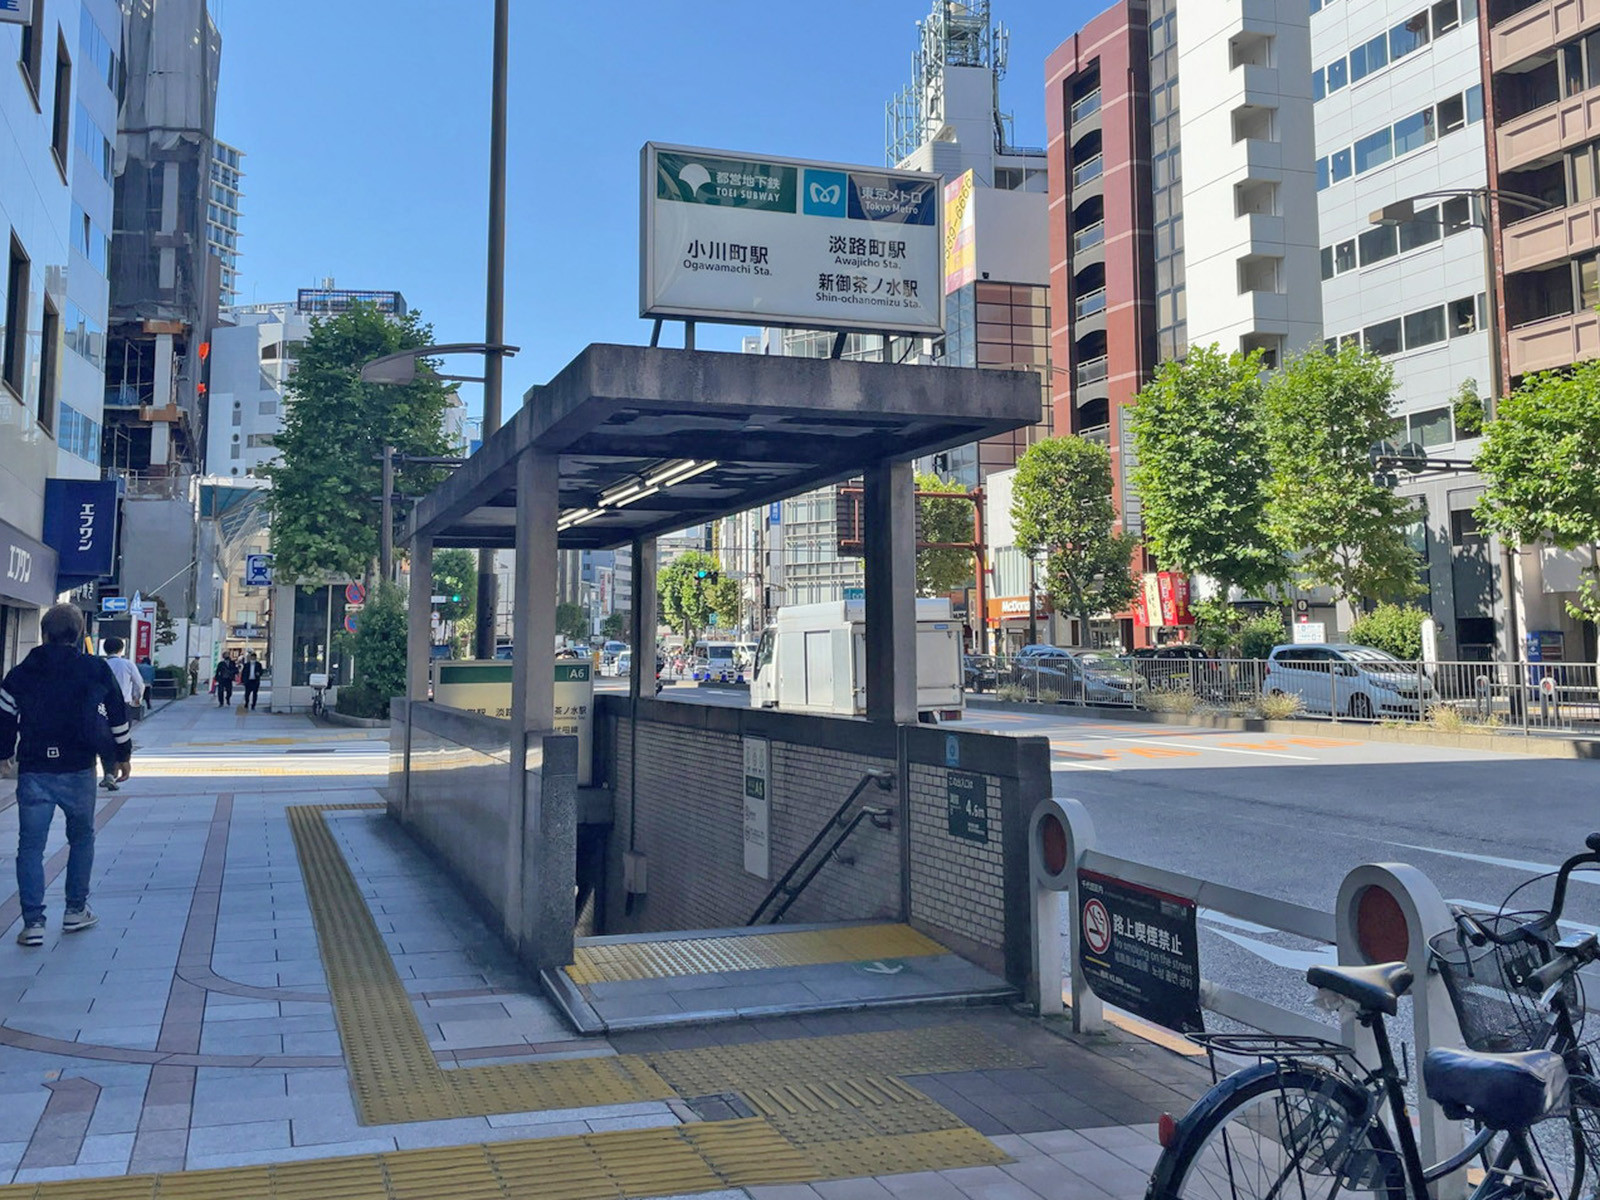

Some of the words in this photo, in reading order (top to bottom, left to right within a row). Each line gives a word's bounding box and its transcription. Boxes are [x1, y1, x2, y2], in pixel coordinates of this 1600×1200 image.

[716, 171, 780, 190] 都営地下鉄
[716, 186, 738, 199] TOEI
[740, 188, 780, 203] SUBWAY
[861, 186, 922, 205] 東京メトロ
[865, 201, 891, 214] Tokyo
[892, 203, 919, 215] Metro
[687, 239, 769, 265] 小川町駅
[829, 234, 907, 260] 淡路町駅
[683, 258, 751, 274] Ogawamachi
[754, 264, 773, 276] Sta.
[835, 255, 880, 271] Awajicho
[883, 258, 902, 270] Sta.
[819, 272, 918, 298] 新御茶ノ水駅
[815, 291, 901, 308] Shin-ochanomizu
[903, 297, 922, 309] Sta.
[78, 503, 95, 551] エフワン
[7, 545, 33, 583] エフワン
[569, 669, 585, 679] A6
[1113, 913, 1184, 956] 路上喫煙禁止
[1123, 942, 1150, 962] smoking
[1150, 951, 1160, 963] on
[1160, 953, 1172, 967] the
[1172, 959, 1193, 975] street
